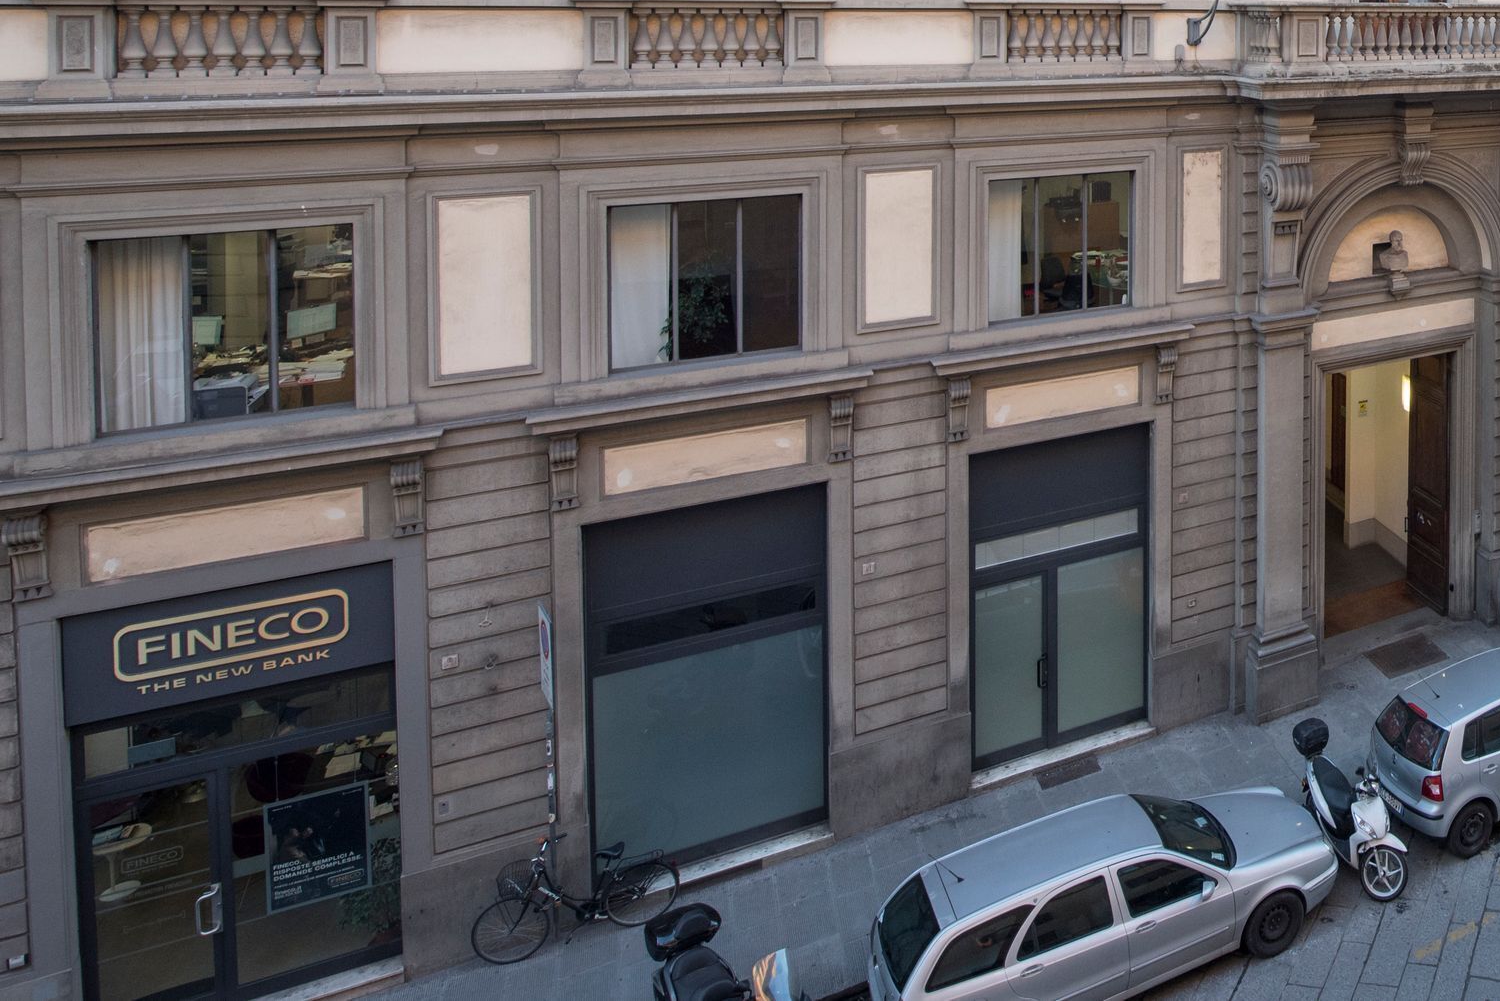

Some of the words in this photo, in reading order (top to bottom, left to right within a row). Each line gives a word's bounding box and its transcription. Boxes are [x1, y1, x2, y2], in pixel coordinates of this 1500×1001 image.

[138, 607, 330, 665] FINECO
[137, 677, 187, 695] THE
[196, 664, 253, 684] NEW
[263, 649, 330, 671] BANK
[126, 850, 178, 869] FINECO
[273, 863, 310, 876] RISPOSTE
[312, 853, 348, 867] SEMPLICI
[273, 868, 313, 882] DOMANDE
